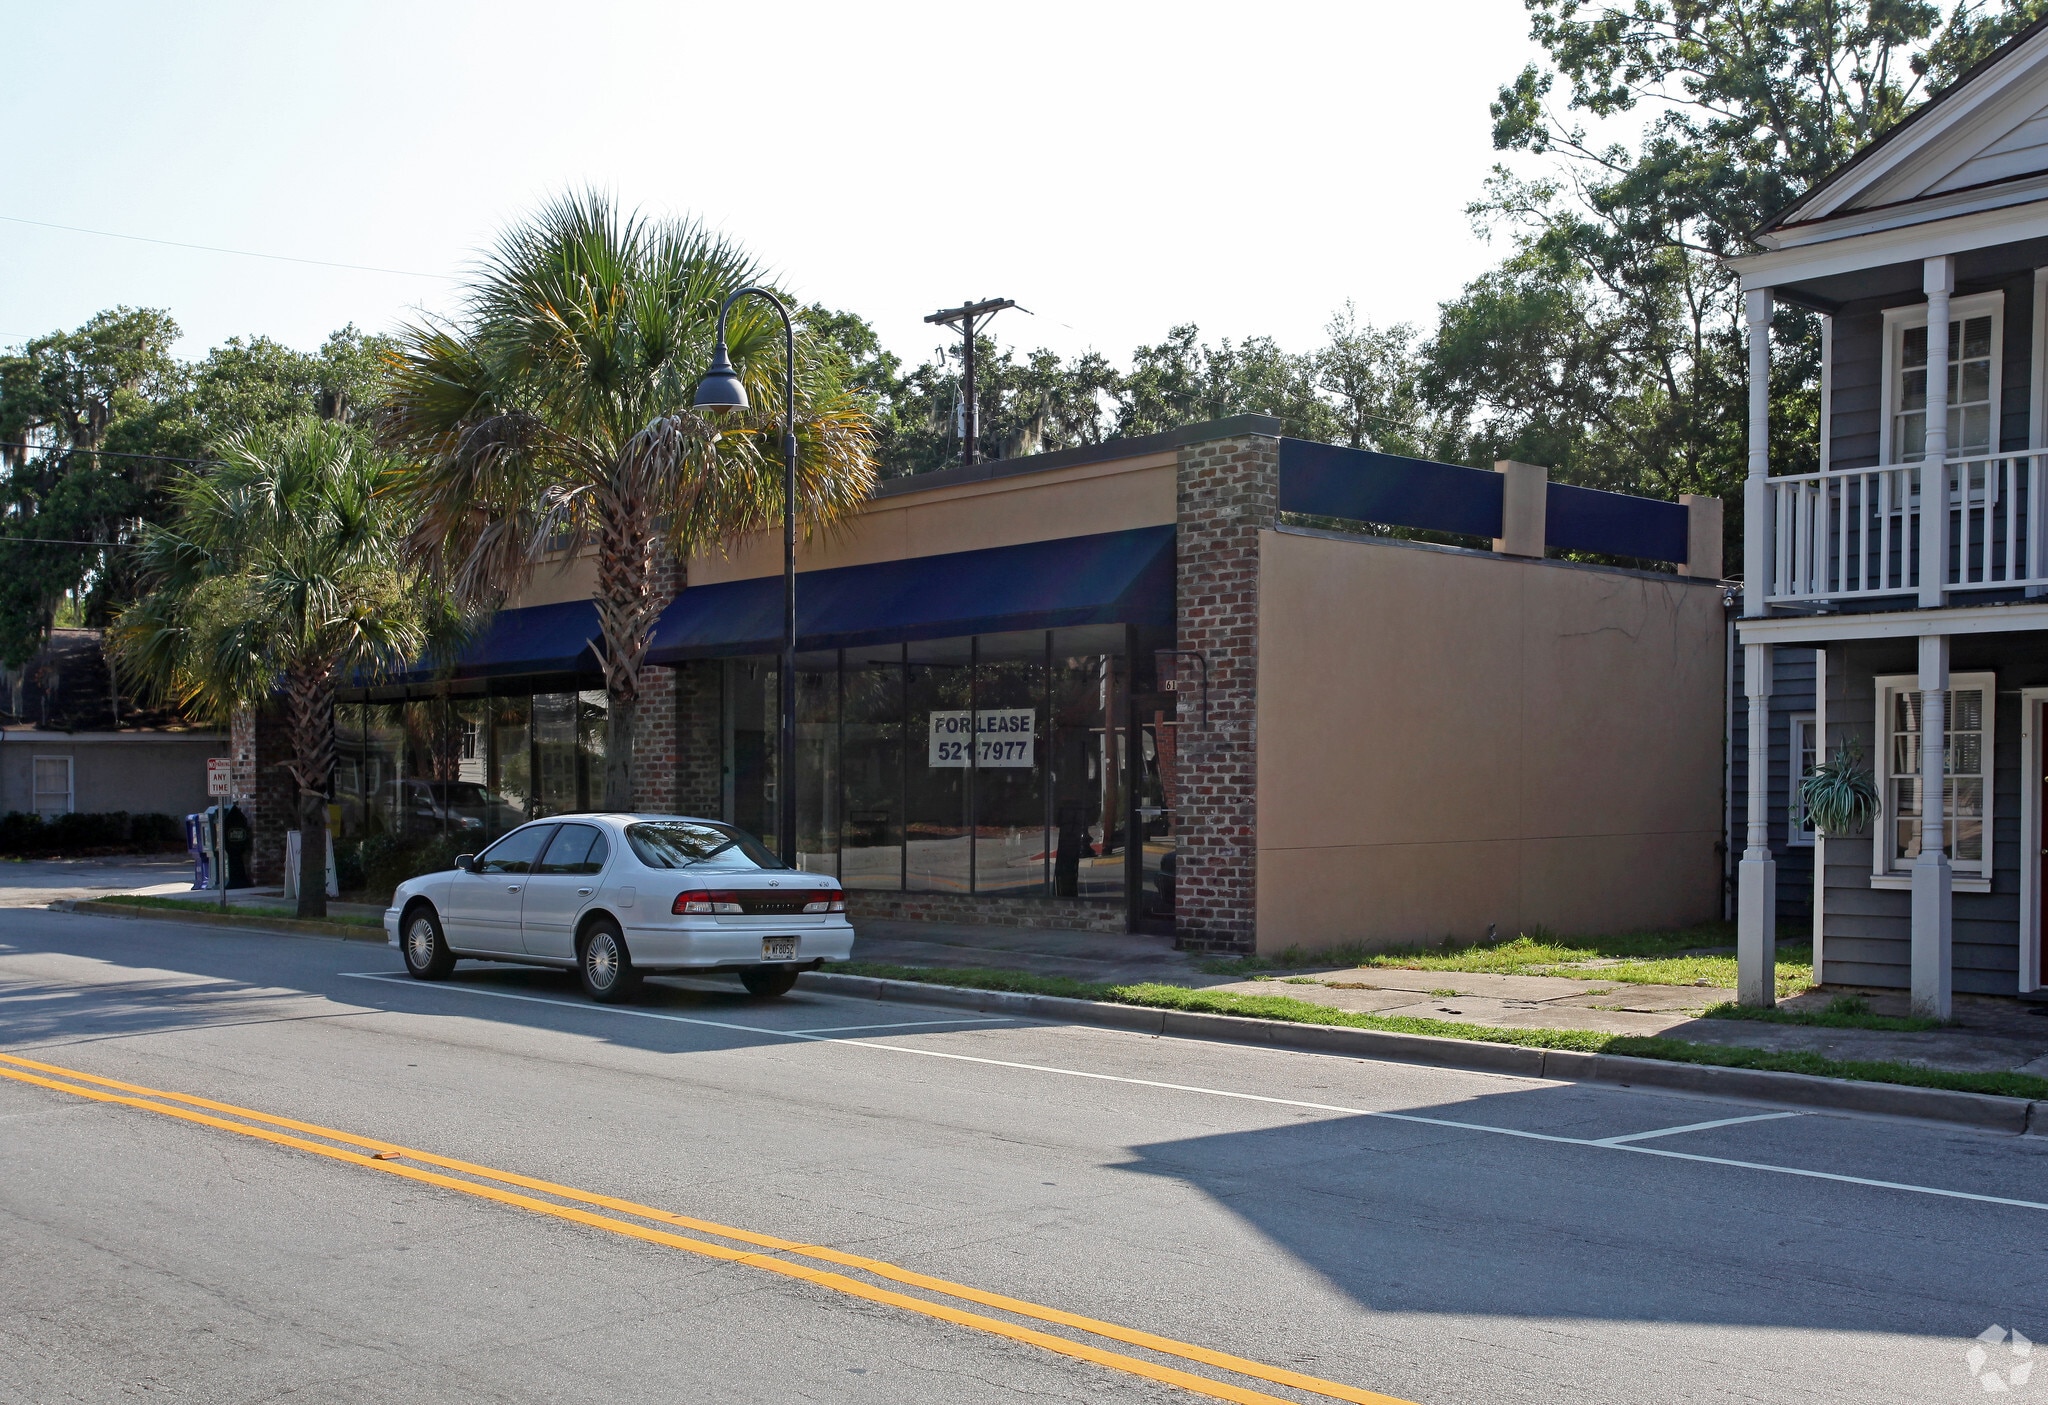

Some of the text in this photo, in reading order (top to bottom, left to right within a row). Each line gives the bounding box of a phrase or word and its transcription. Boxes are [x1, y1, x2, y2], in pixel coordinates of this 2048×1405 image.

[1166, 680, 1176, 690] 61
[935, 715, 1030, 734] FOR LEASE
[938, 741, 1027, 760] 521-7977
[213, 773, 226, 781] ANY
[212, 783, 228, 791] TIME
